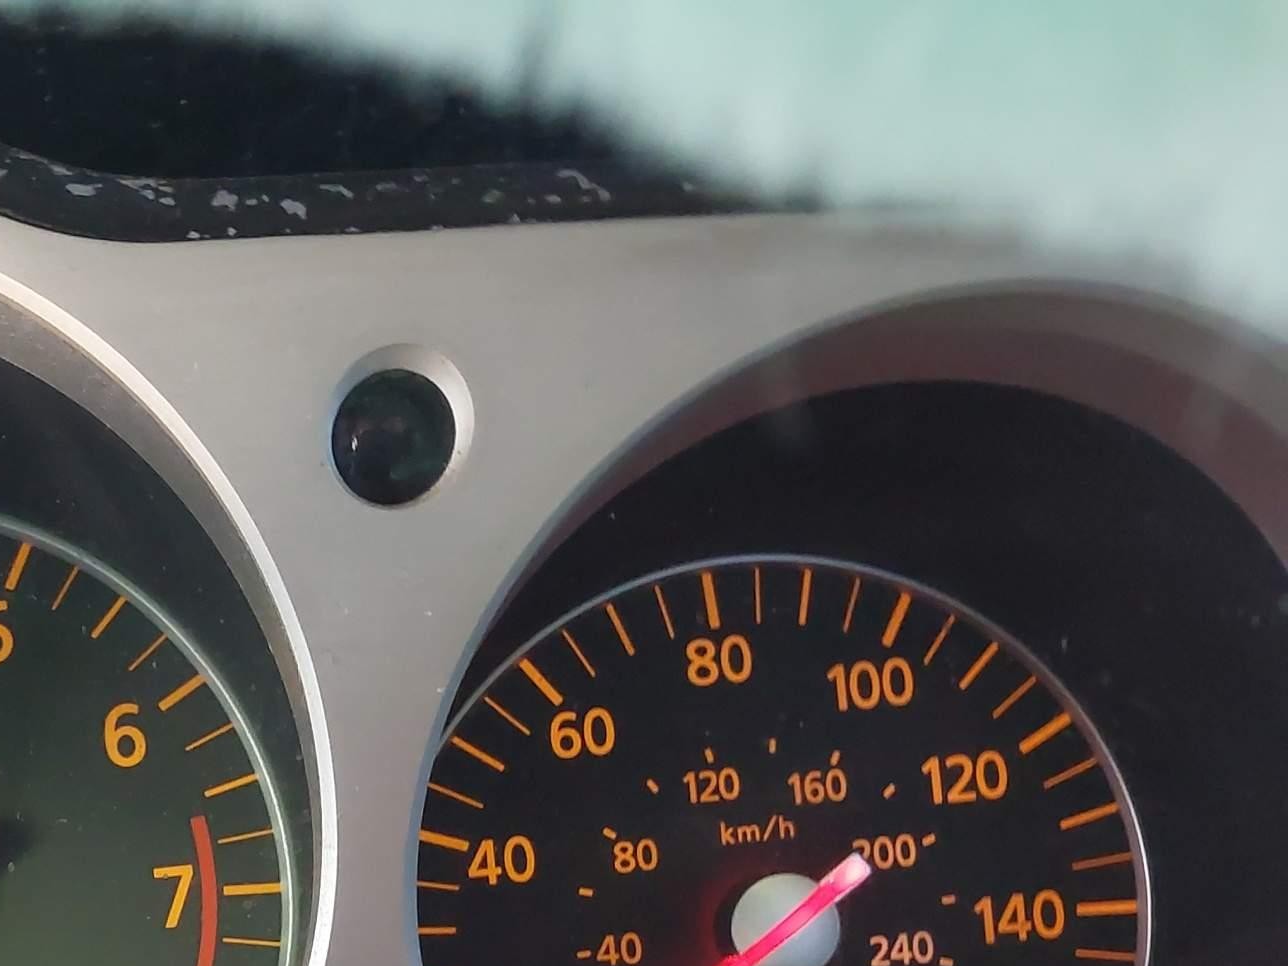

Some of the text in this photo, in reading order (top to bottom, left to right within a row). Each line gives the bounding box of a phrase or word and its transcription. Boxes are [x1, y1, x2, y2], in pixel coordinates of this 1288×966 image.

[686, 634, 752, 687] 80
[826, 656, 914, 712] 100
[103, 702, 147, 768] 6
[549, 707, 616, 759] 60
[682, 771, 740, 804] 120
[787, 768, 847, 805] 160
[921, 750, 1008, 805] 120
[613, 839, 658, 874] 80
[720, 815, 795, 846] km/h
[467, 835, 536, 886] 40
[152, 863, 196, 929] 7
[974, 889, 1065, 945] 140
[596, 932, 643, 966] 40
